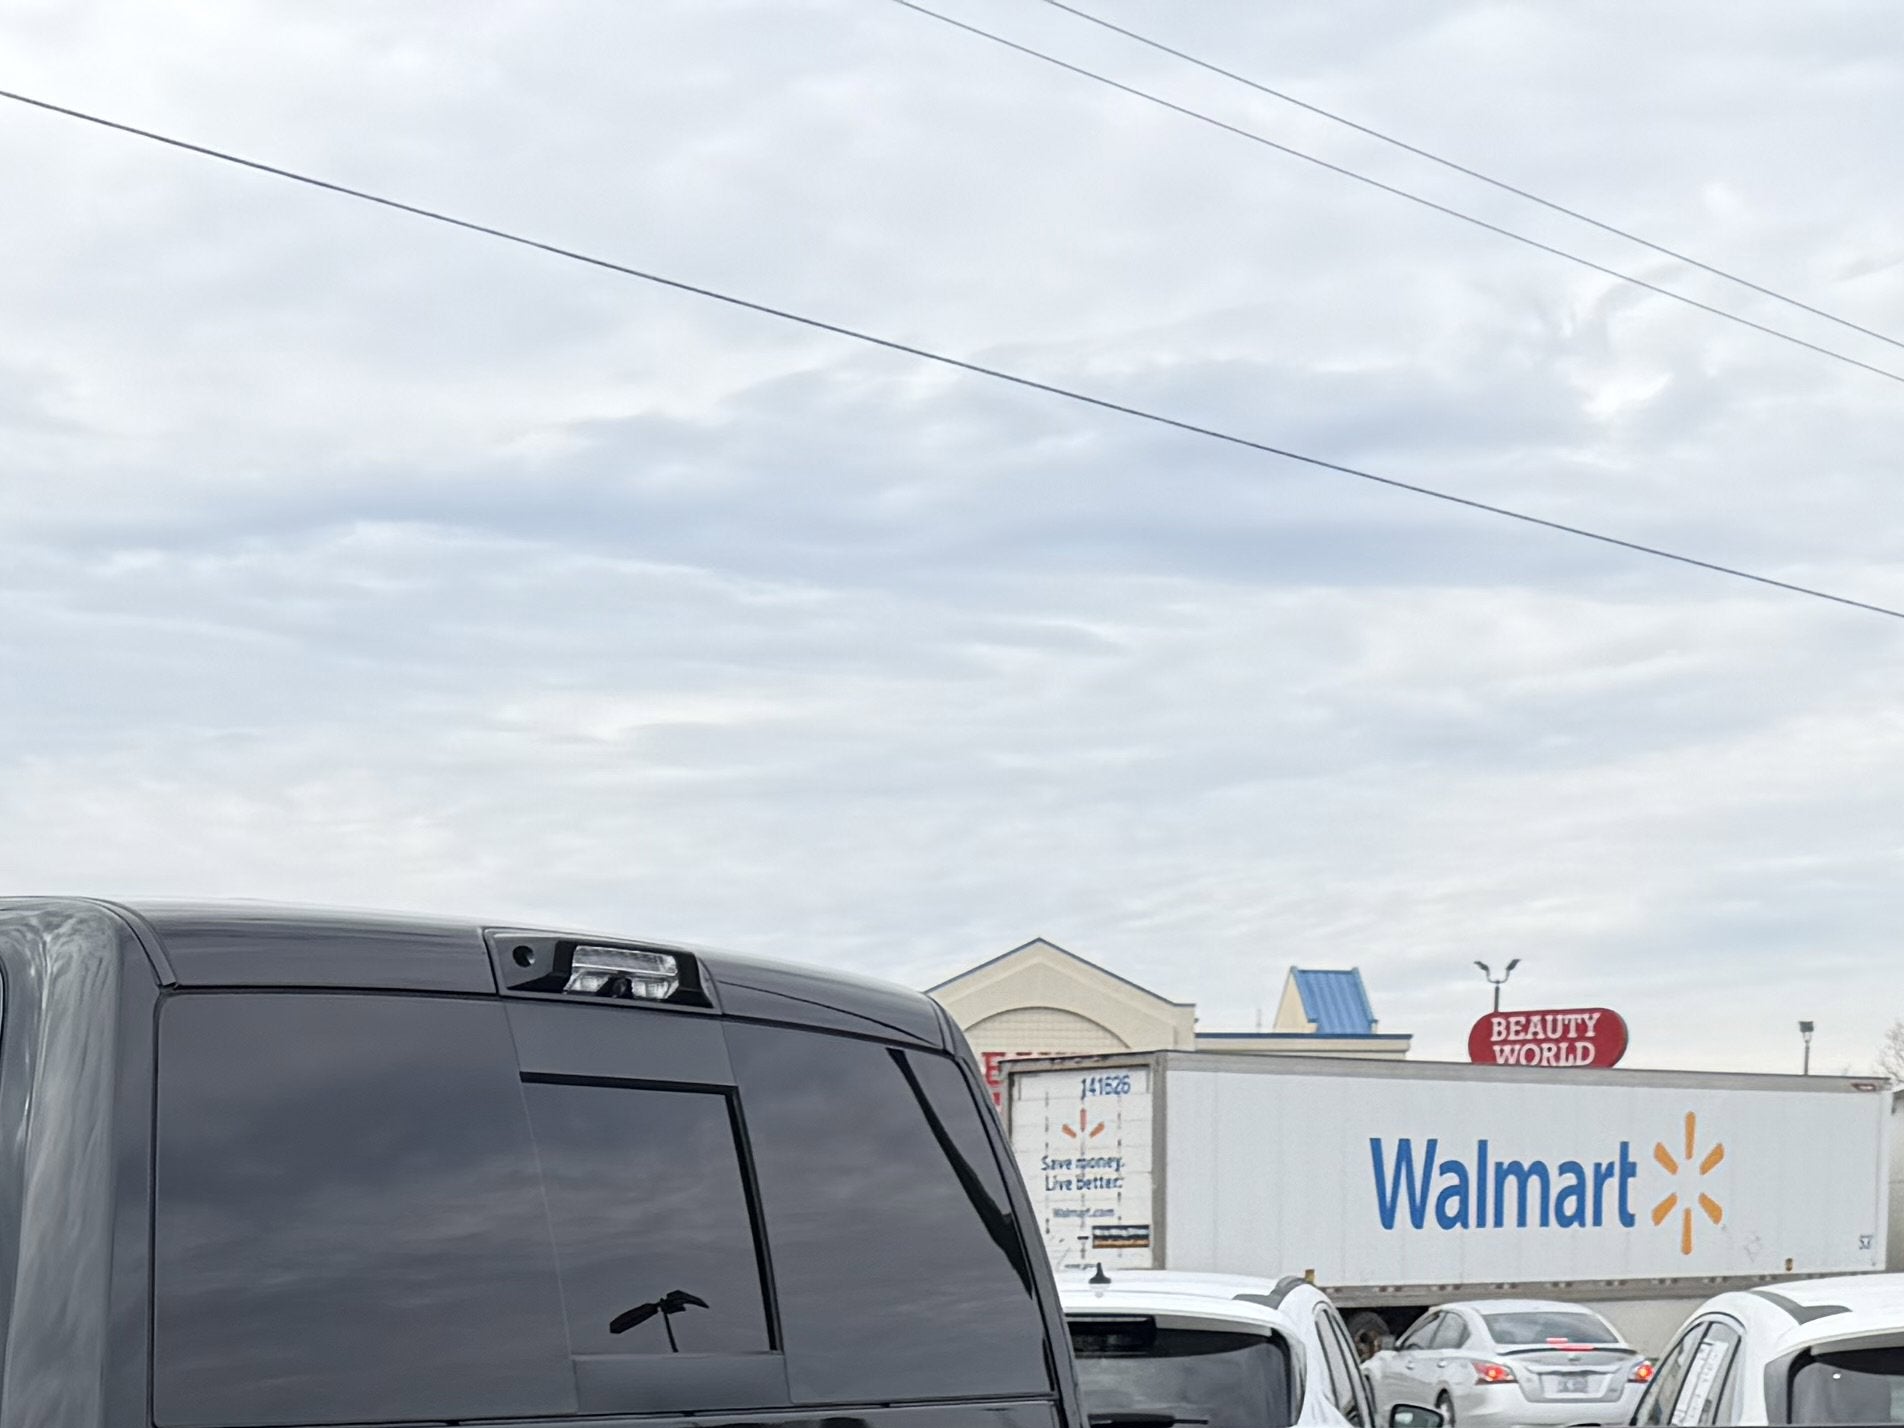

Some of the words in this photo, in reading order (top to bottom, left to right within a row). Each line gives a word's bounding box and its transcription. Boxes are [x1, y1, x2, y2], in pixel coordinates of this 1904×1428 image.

[1490, 1012, 1601, 1041] BEAUTY
[1493, 1041, 1596, 1067] WORLD
[1041, 1156, 1072, 1171] Save
[1045, 1175, 1073, 1191] Live
[1369, 1138, 1637, 1230] Walmart
